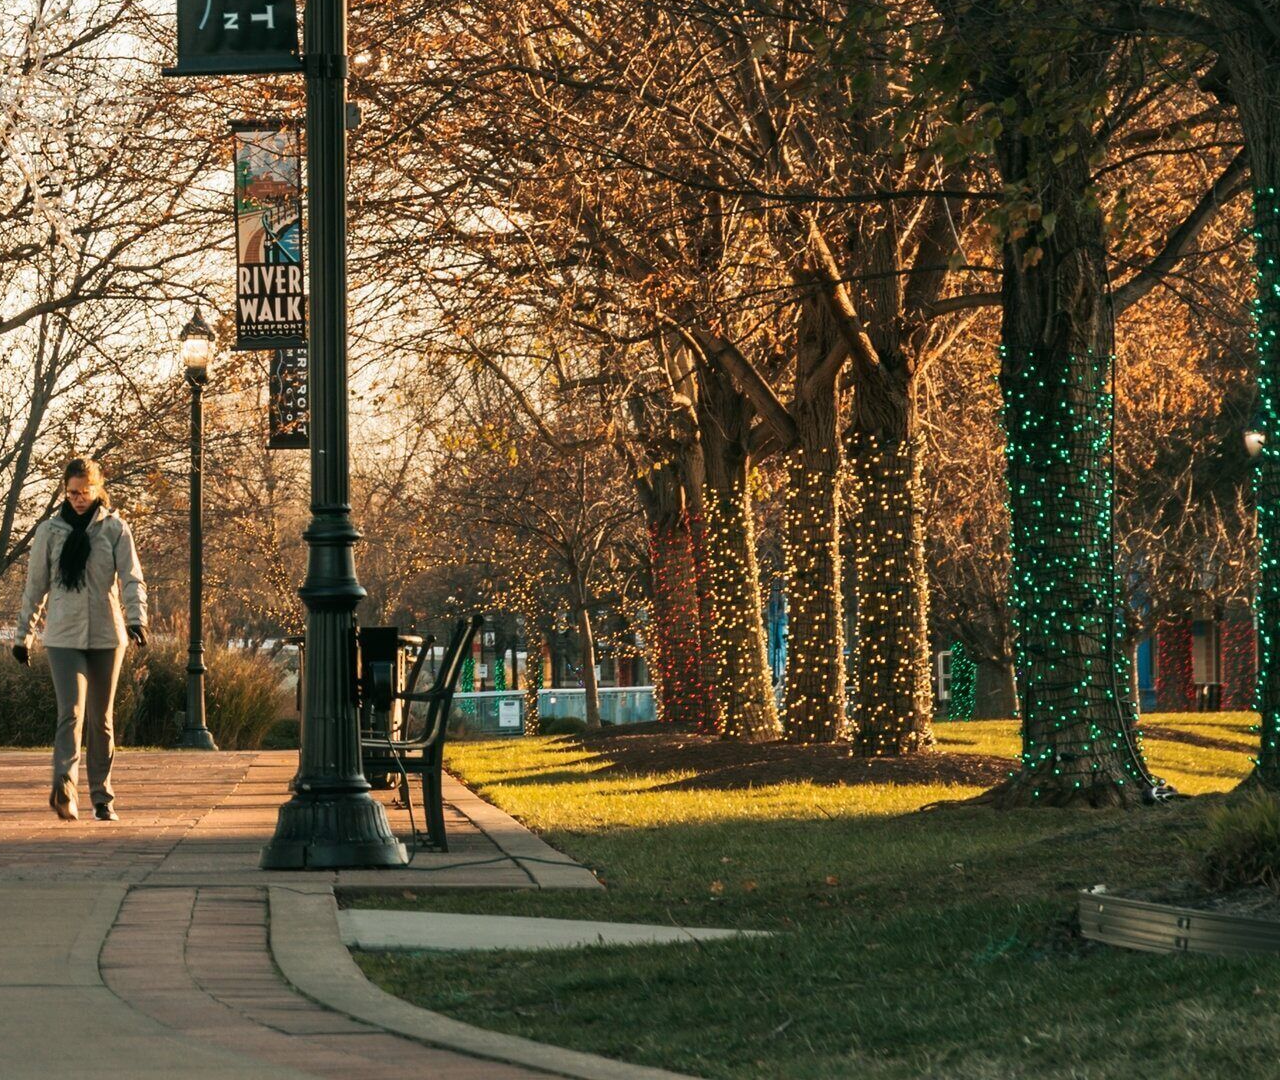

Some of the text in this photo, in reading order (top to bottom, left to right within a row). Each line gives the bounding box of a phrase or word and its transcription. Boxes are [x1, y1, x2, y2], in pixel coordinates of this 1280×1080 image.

[238, 265, 302, 295] RIVER
[239, 296, 302, 323] WALK
[240, 323, 303, 331] RIVERFRONT
